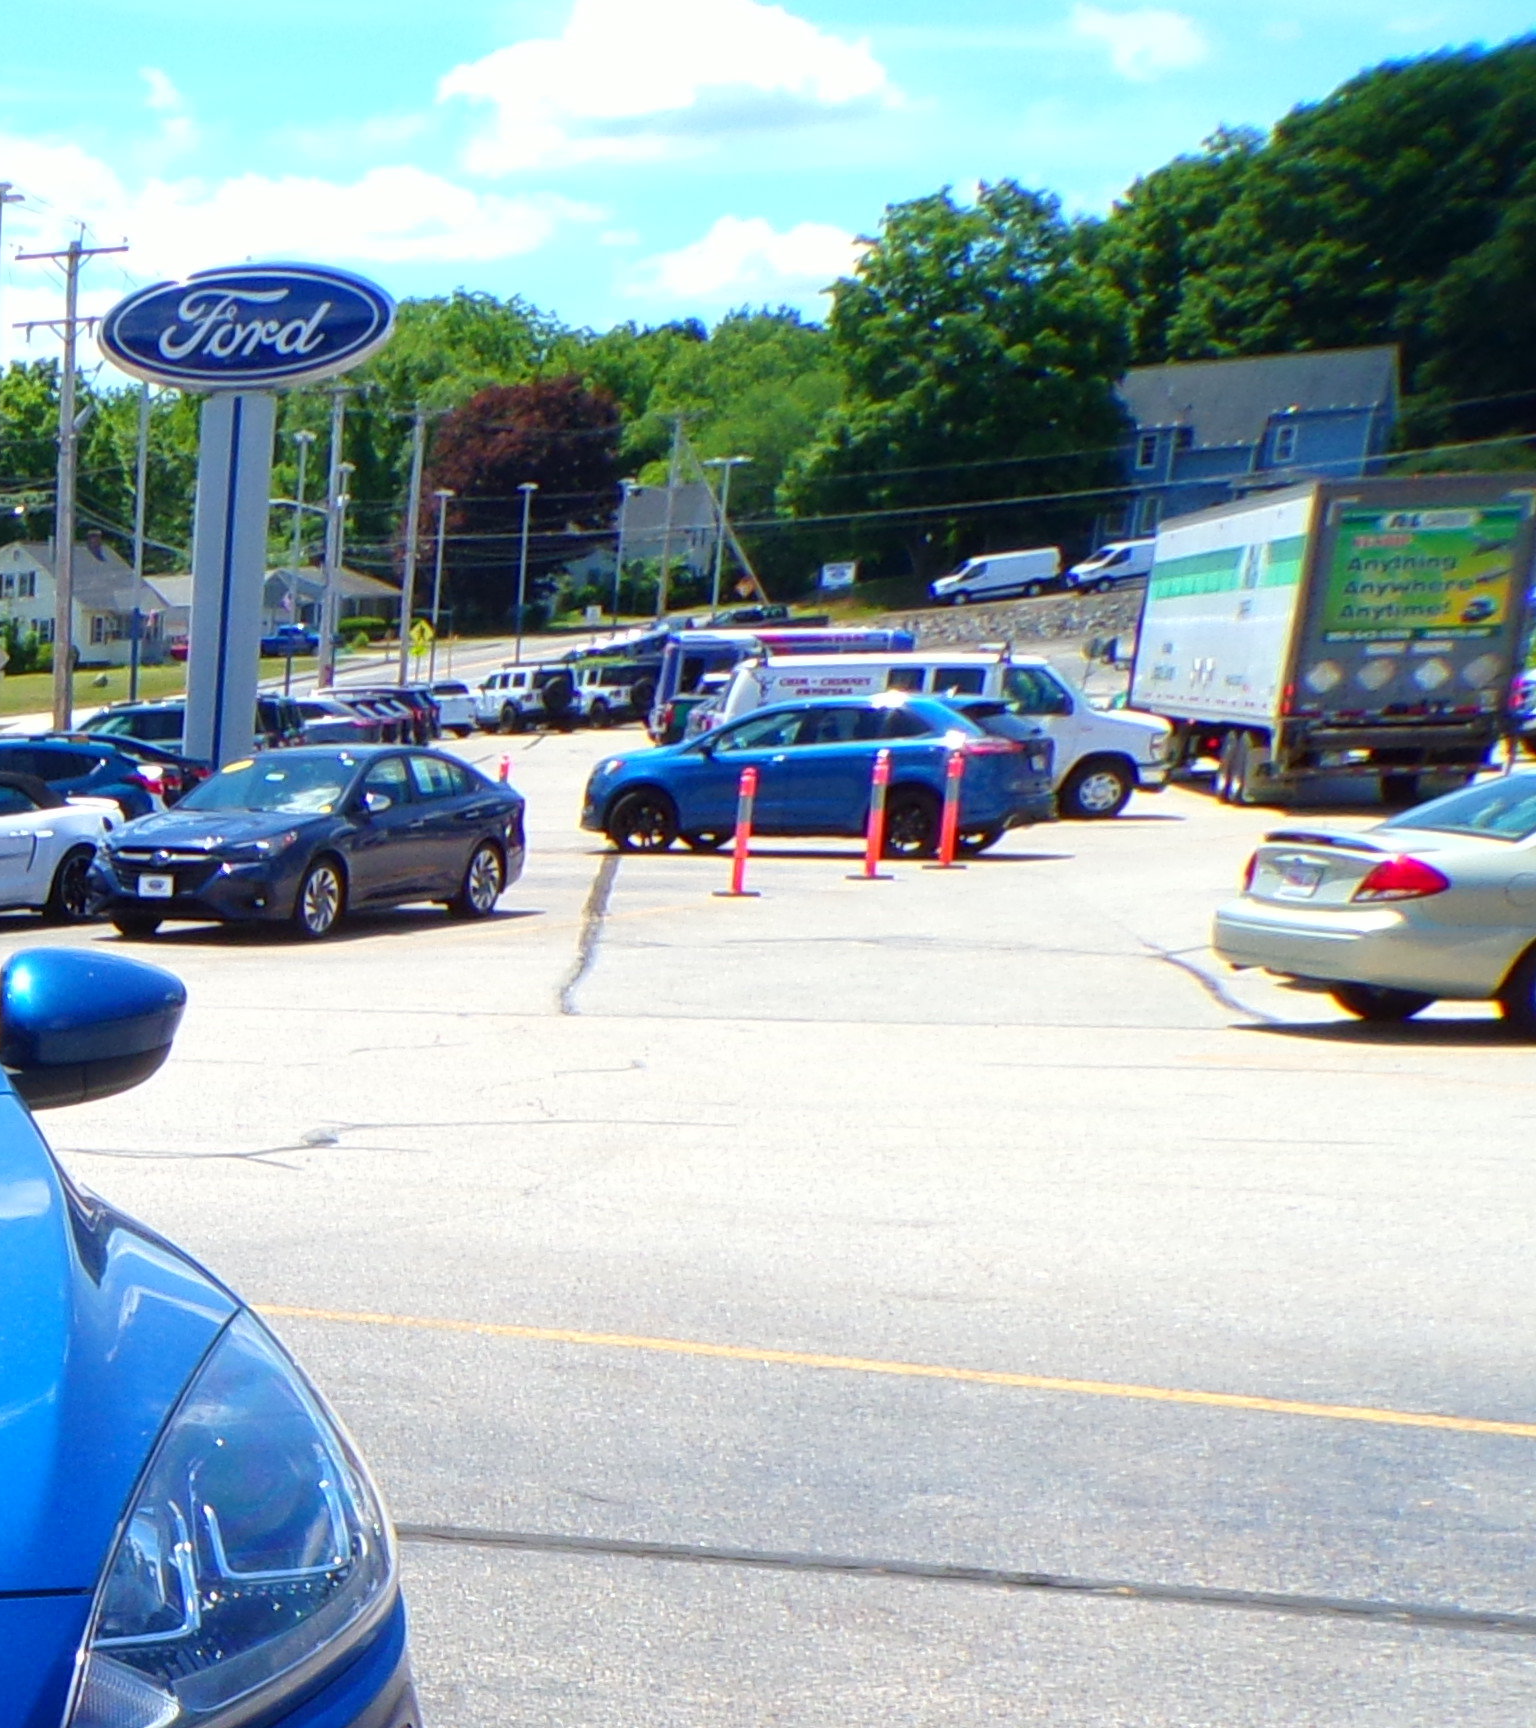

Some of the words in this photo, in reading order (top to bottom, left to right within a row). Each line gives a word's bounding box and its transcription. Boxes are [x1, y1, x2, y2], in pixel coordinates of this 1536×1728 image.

[159, 287, 331, 360] Ford
[1348, 555, 1457, 572] Anything
[1344, 578, 1473, 596] Anywhere
